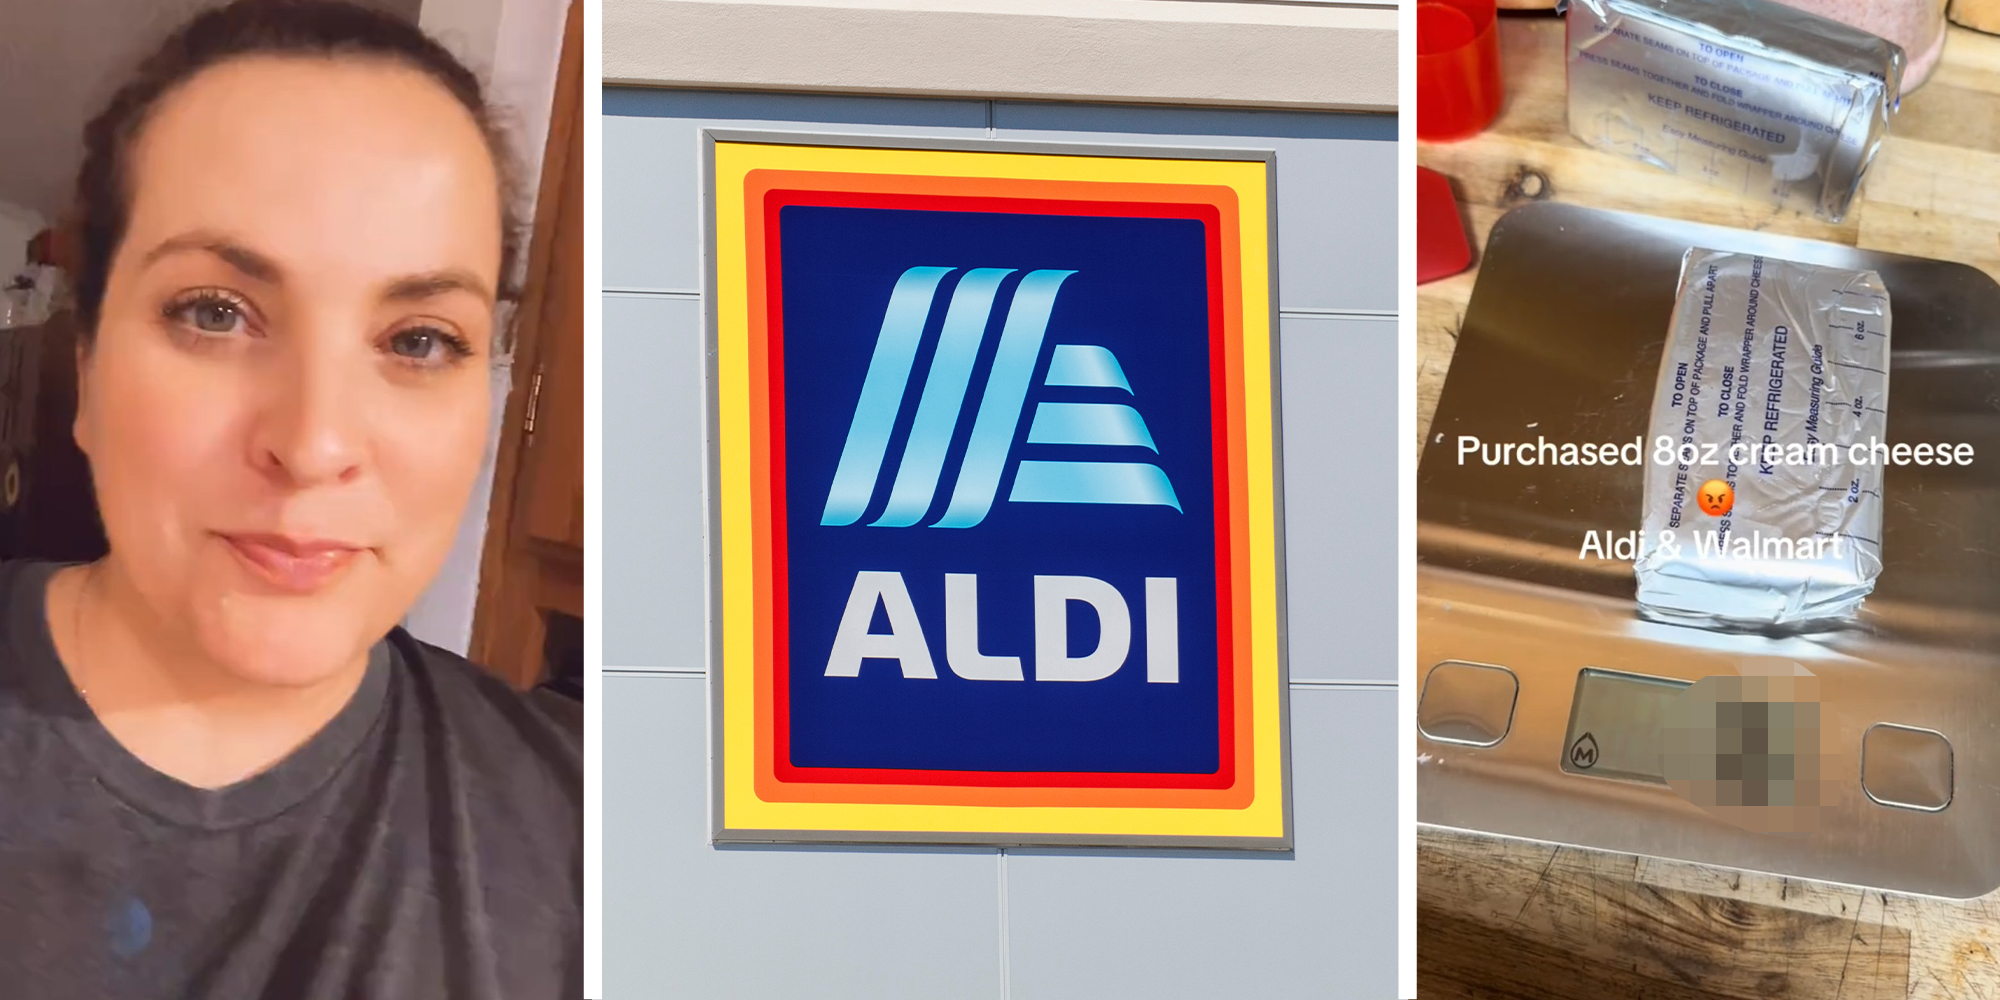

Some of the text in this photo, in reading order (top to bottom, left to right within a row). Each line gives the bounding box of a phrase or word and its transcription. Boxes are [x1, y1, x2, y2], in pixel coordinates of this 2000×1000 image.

[1643, 37, 1674, 54] SEAMS
[1676, 48, 1689, 58] ON
[1692, 52, 1710, 64] TOP
[1712, 59, 1725, 68] OF
[1727, 64, 1771, 84] PACKAGE
[1774, 77, 1793, 89] AND
[1699, 43, 1744, 62] TO OPEN
[1580, 50, 1609, 65] PRESS
[1610, 59, 1640, 75] SEAMS
[1642, 70, 1690, 92] TOGETHER
[1691, 87, 1709, 98] AND
[1711, 93, 1735, 108] FOLD
[1737, 101, 1782, 121] WRAPPER
[1784, 114, 1823, 134] AROUND
[1694, 75, 1744, 98] TO CLOSE
[1648, 93, 1786, 145] KEEP REFRIGERATED
[1662, 124, 1767, 165] Easy Measuring Guide
[1706, 265, 1718, 292] APART
[1703, 293, 1714, 320] PULL
[1746, 289, 1759, 328] AROUND
[1700, 316, 1711, 335] AND
[1855, 333, 1864, 341] 6
[1693, 336, 1708, 380] PACKAGE
[1740, 328, 1754, 374] WRAPPER
[1810, 344, 1823, 375] Guide
[1672, 362, 1688, 407] TO OPEN
[1690, 380, 1701, 396] OF
[1718, 366, 1734, 417] TO CLOSE
[1737, 375, 1749, 399] FOLD
[1764, 325, 1788, 432] REFRIGERATED
[1687, 396, 1699, 417] TOP
[1734, 401, 1746, 422] AND
[1805, 375, 1824, 432] Measuring
[1852, 395, 1863, 418] 4 oz.
[1684, 419, 1695, 434] ON
[1670, 472, 1687, 529] SEPARATE
[1848, 478, 1860, 503] 2 oz.
[824, 571, 1179, 683] ALDI
